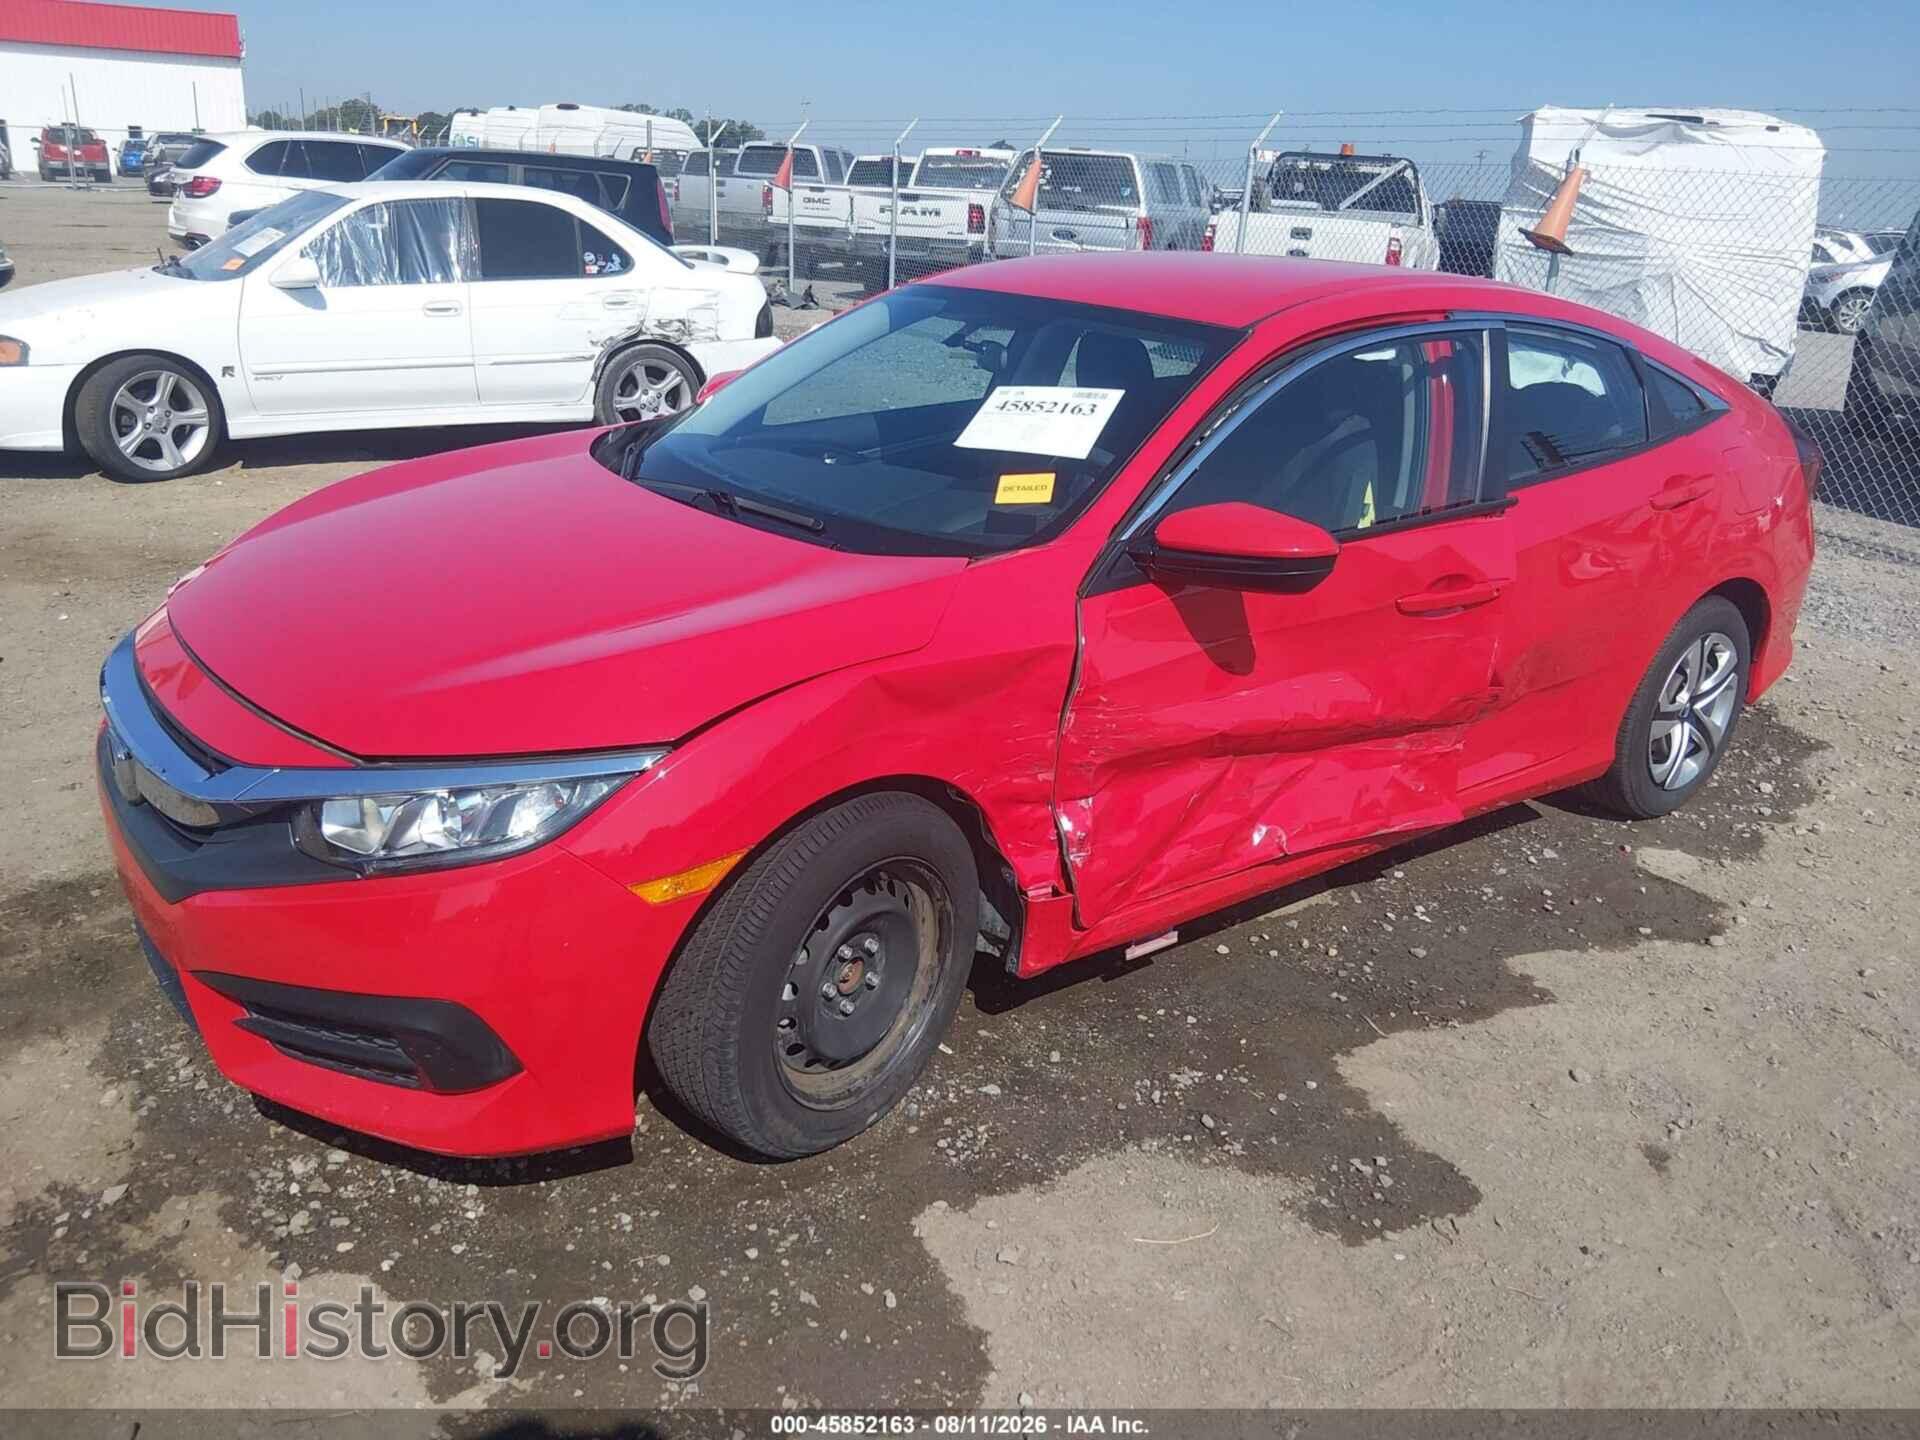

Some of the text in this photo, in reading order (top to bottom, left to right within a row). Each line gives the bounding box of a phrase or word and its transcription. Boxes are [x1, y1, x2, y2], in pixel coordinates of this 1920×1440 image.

[803, 196, 831, 205] GMC
[879, 205, 941, 217] RAM
[995, 399, 1098, 417] 45852163
[1003, 484, 1048, 493] DETAILED
